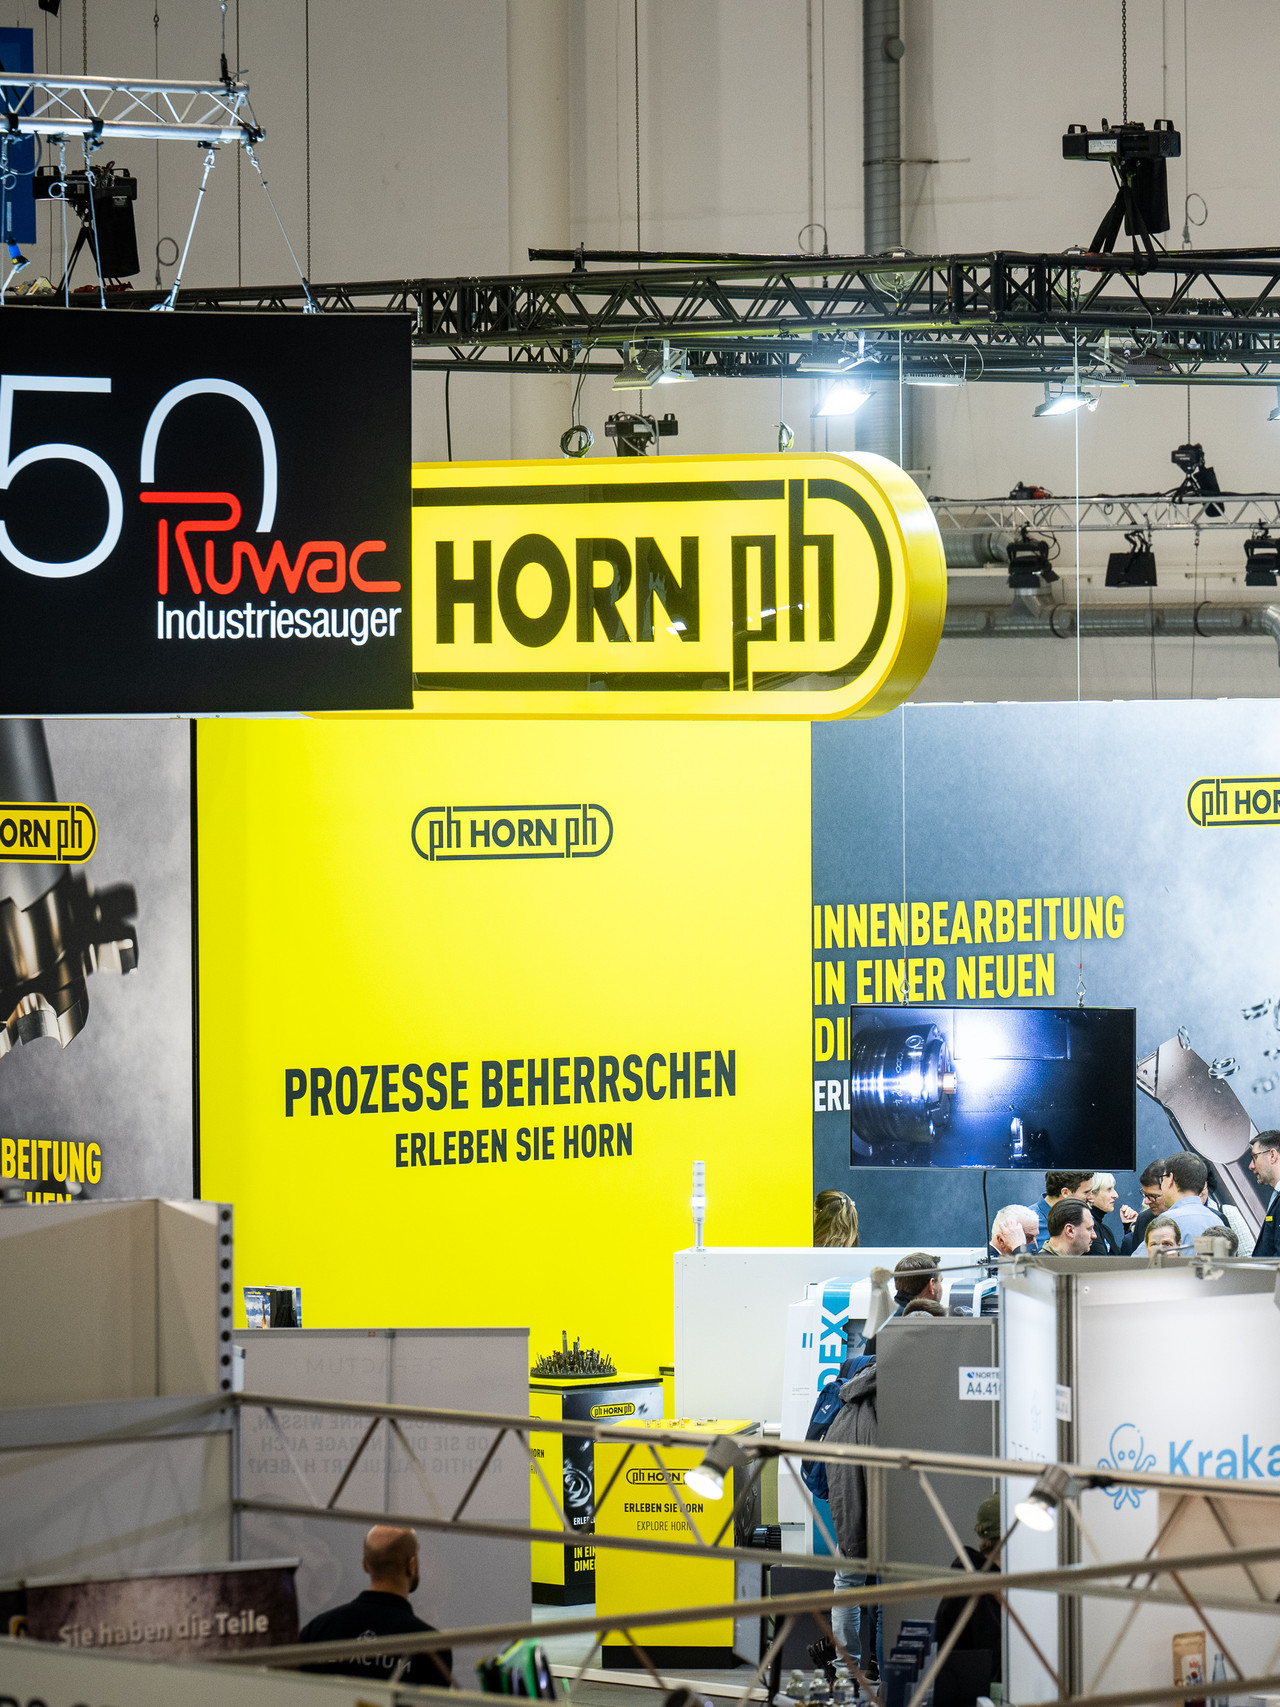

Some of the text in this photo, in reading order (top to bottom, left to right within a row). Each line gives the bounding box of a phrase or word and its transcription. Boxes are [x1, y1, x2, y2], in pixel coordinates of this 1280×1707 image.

[140, 491, 401, 596] Ruwac
[435, 533, 700, 648] HORN
[157, 600, 402, 646] Industriesauger
[469, 818, 558, 848] HORN
[813, 895, 1124, 949] INNENBEARBEITUNG
[814, 952, 1055, 1006] IN EINER NEUEN
[814, 1017, 851, 1062] DI
[284, 1049, 737, 1117] PROZESSE BEHERRSCHEN
[1, 1137, 101, 1184] BEITUNG
[395, 1122, 633, 1168] ERLEBEN SIE HORN
[603, 1406, 623, 1415] HORN
[624, 1503, 662, 1513] ERLEBEN
[664, 1503, 678, 1513] SIE
[636, 1520, 669, 1532] EXPLORE
[573, 1547, 583, 1559] IN
[98, 1619, 171, 1647] haben
[178, 1612, 212, 1638] die
[215, 1609, 269, 1636] Teile
